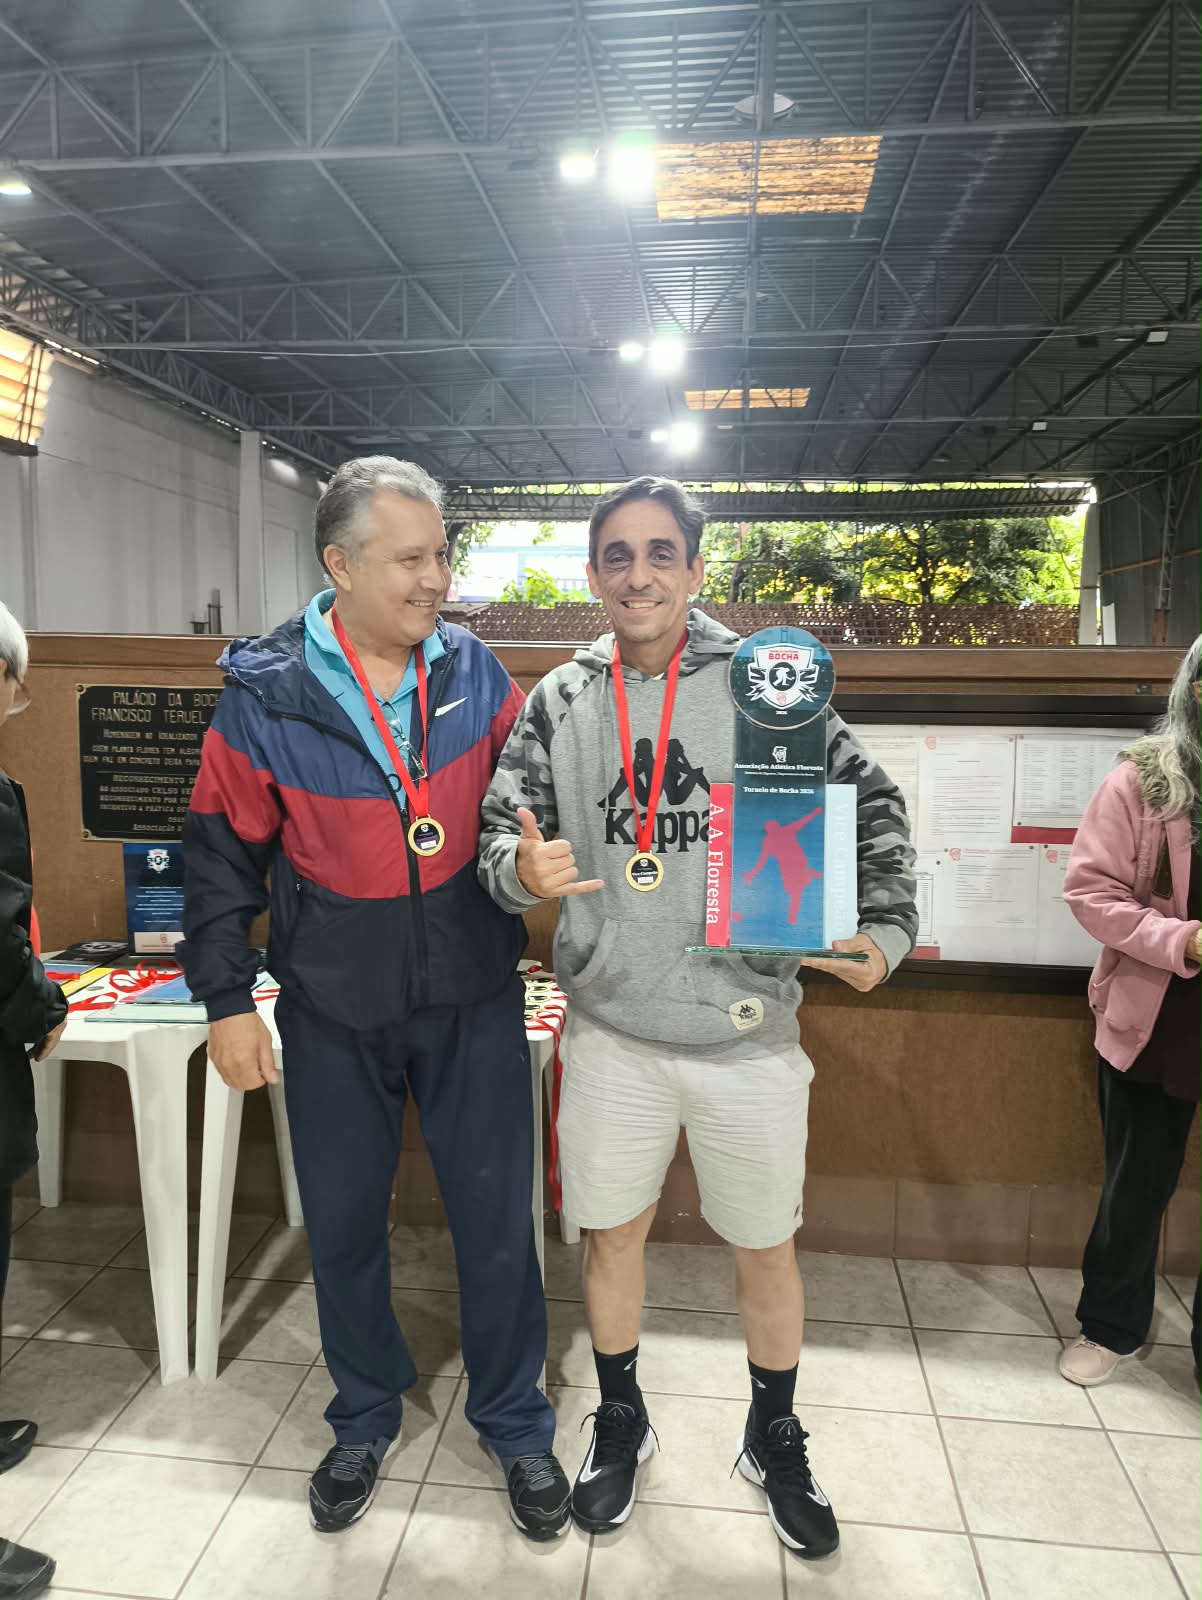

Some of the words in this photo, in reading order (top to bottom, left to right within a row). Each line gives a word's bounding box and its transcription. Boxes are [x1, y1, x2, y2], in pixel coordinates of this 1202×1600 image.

[768, 652, 799, 660] BOCHA
[113, 689, 157, 706] PALÁCIO
[168, 693, 182, 706] DA
[91, 707, 152, 723] FRANCISCO
[163, 709, 207, 724] TERUEL
[734, 761, 769, 771] Associação
[770, 762, 796, 771] Atlética
[796, 763, 824, 772] Floresta
[743, 786, 769, 794] Torneio
[770, 786, 778, 794] de
[779, 787, 799, 795] Bocha
[709, 803, 724, 822] A.
[707, 827, 724, 846] A.
[706, 850, 723, 925] Floresta
